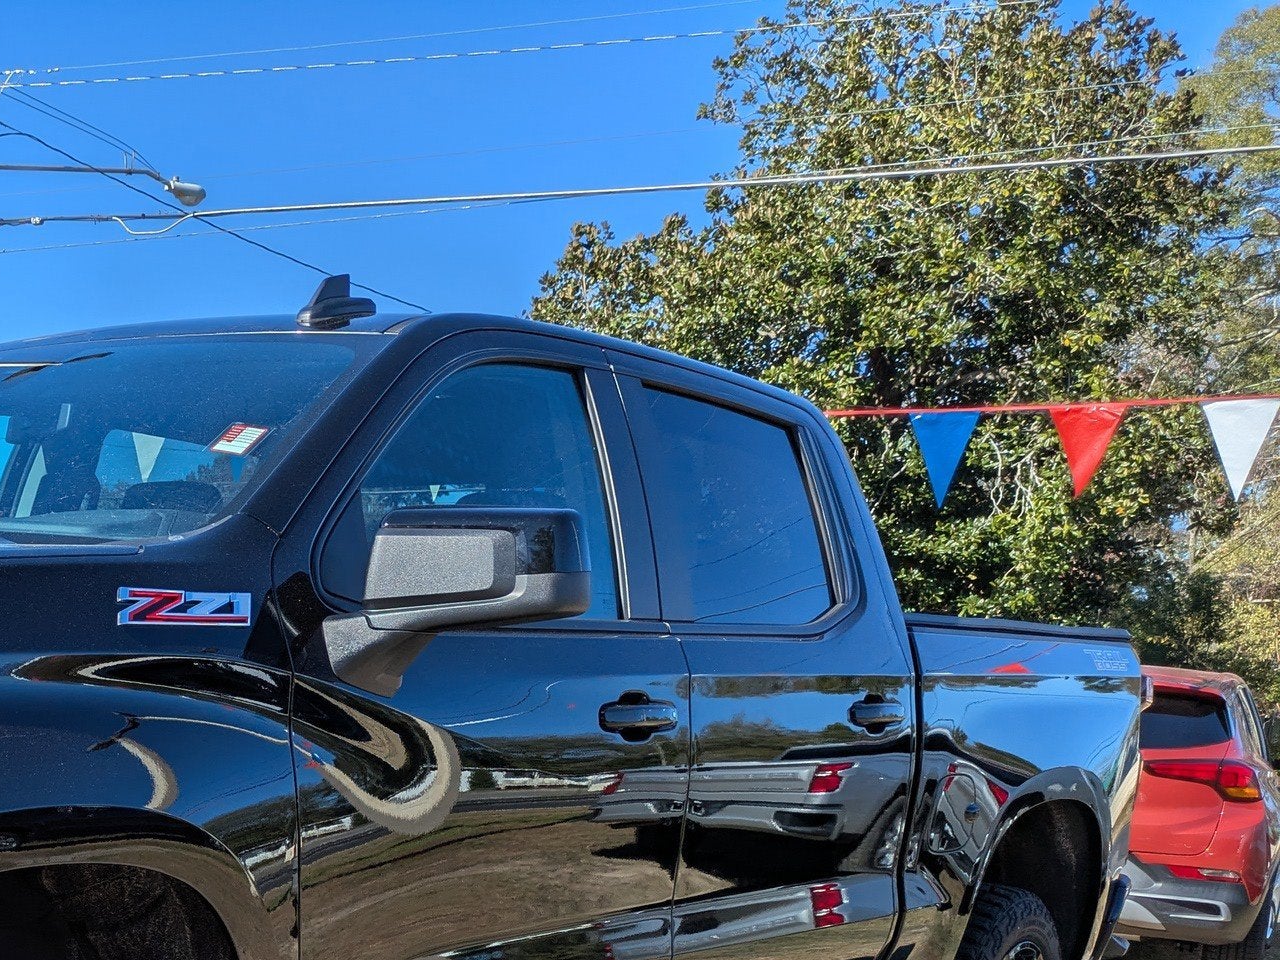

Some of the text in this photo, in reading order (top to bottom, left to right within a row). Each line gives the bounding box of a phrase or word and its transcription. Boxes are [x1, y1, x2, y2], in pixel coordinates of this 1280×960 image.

[117, 587, 251, 626] Z71
[1083, 648, 1129, 663] TRAIL
[1095, 660, 1128, 671] BOSS
